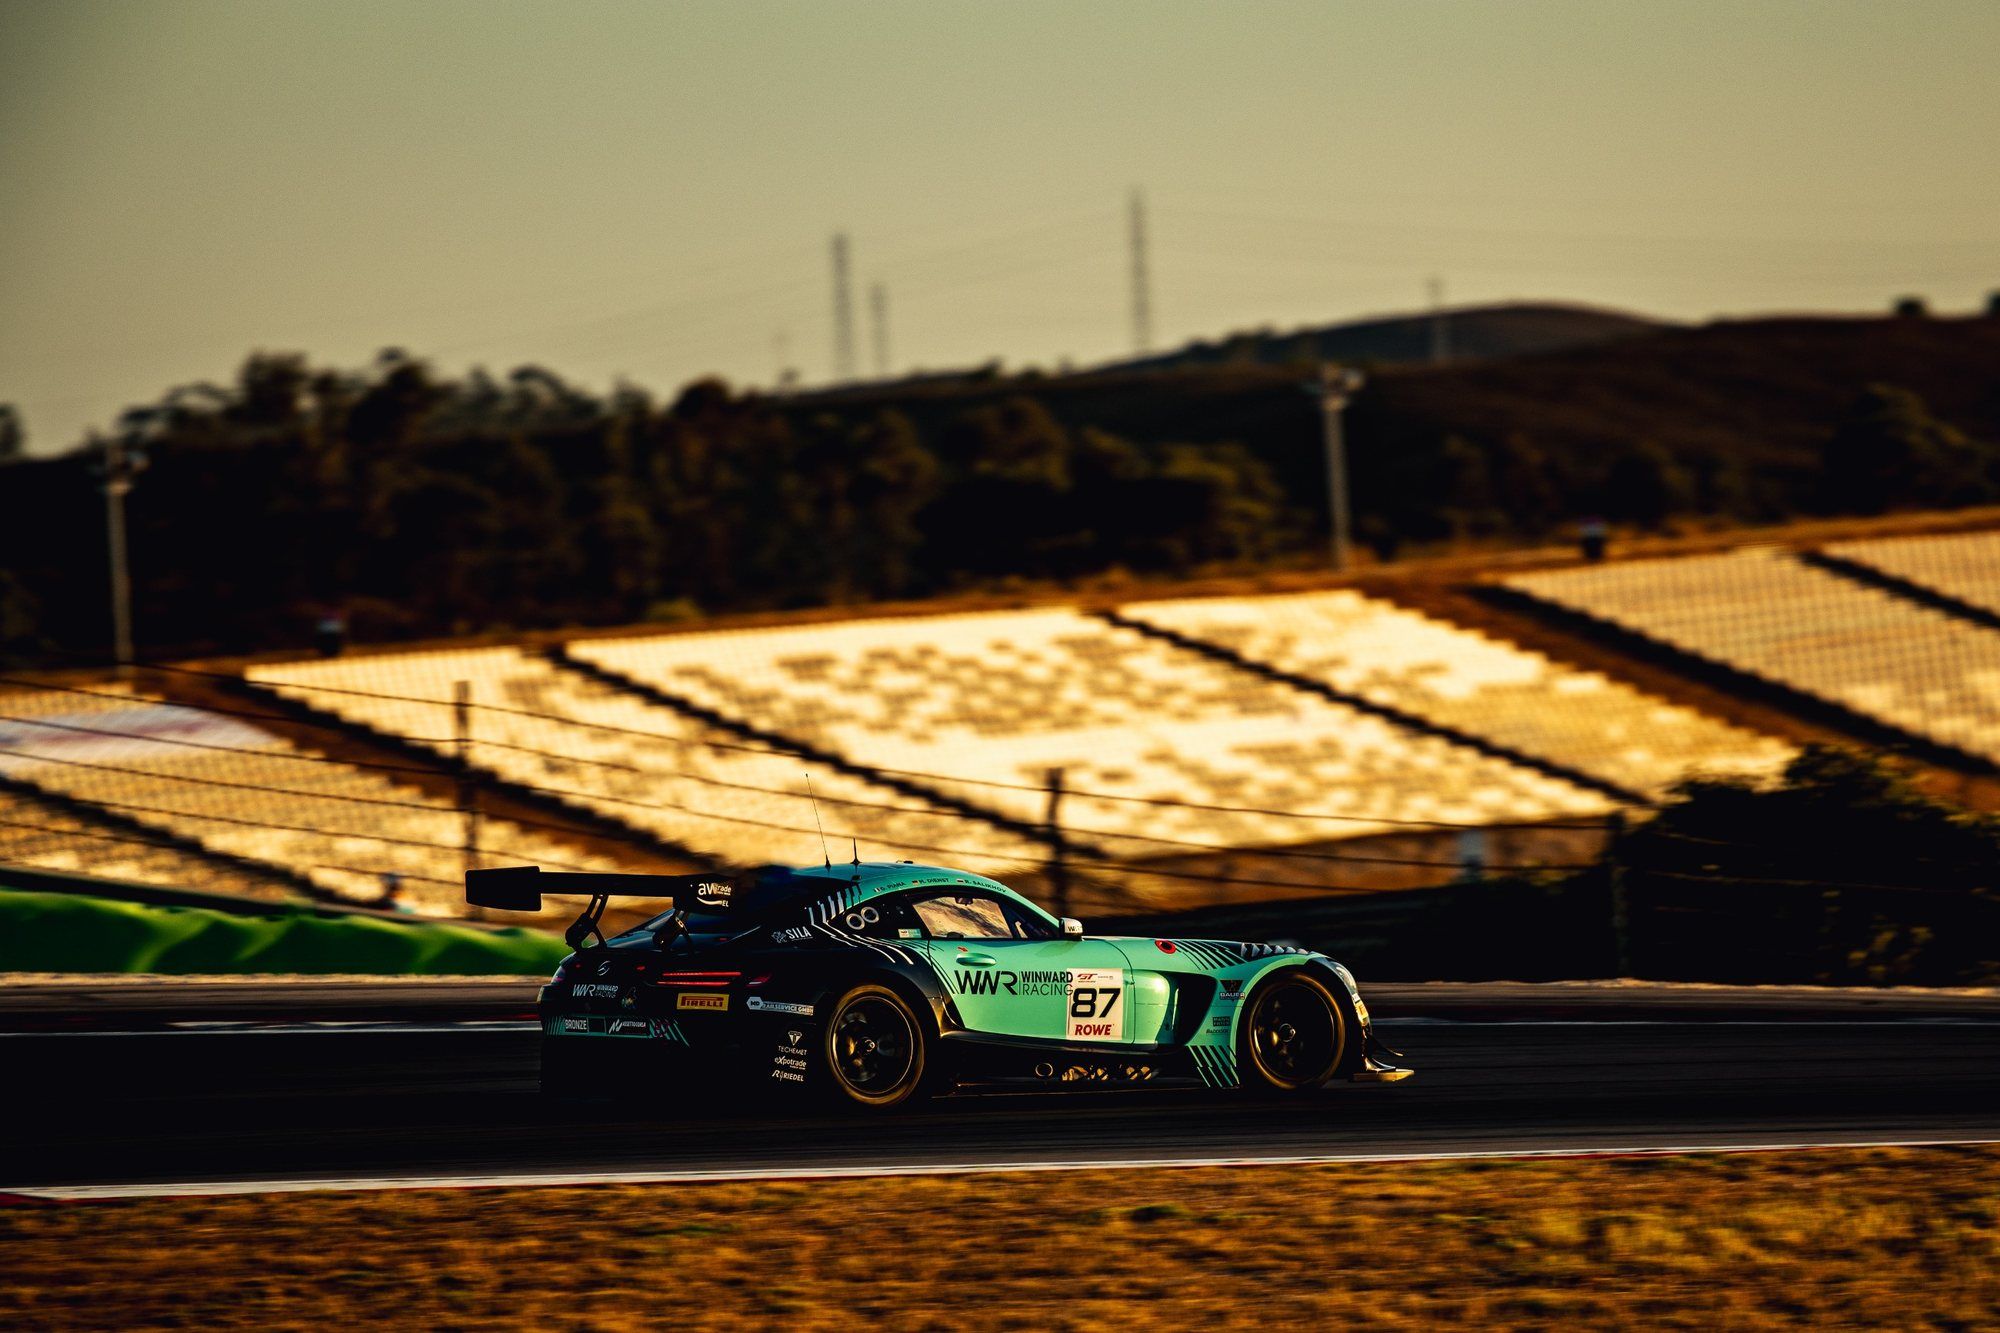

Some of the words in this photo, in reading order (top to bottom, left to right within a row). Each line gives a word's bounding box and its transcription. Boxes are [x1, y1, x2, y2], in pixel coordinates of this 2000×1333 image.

[785, 926, 813, 939] SILA
[1021, 971, 1073, 983] WINWARD
[1022, 984, 1073, 996] RACING
[680, 997, 724, 1008] PIRELLI
[1071, 988, 1121, 1018] 87
[565, 1019, 588, 1030] BRONZE
[1075, 1024, 1112, 1036] ROWE
